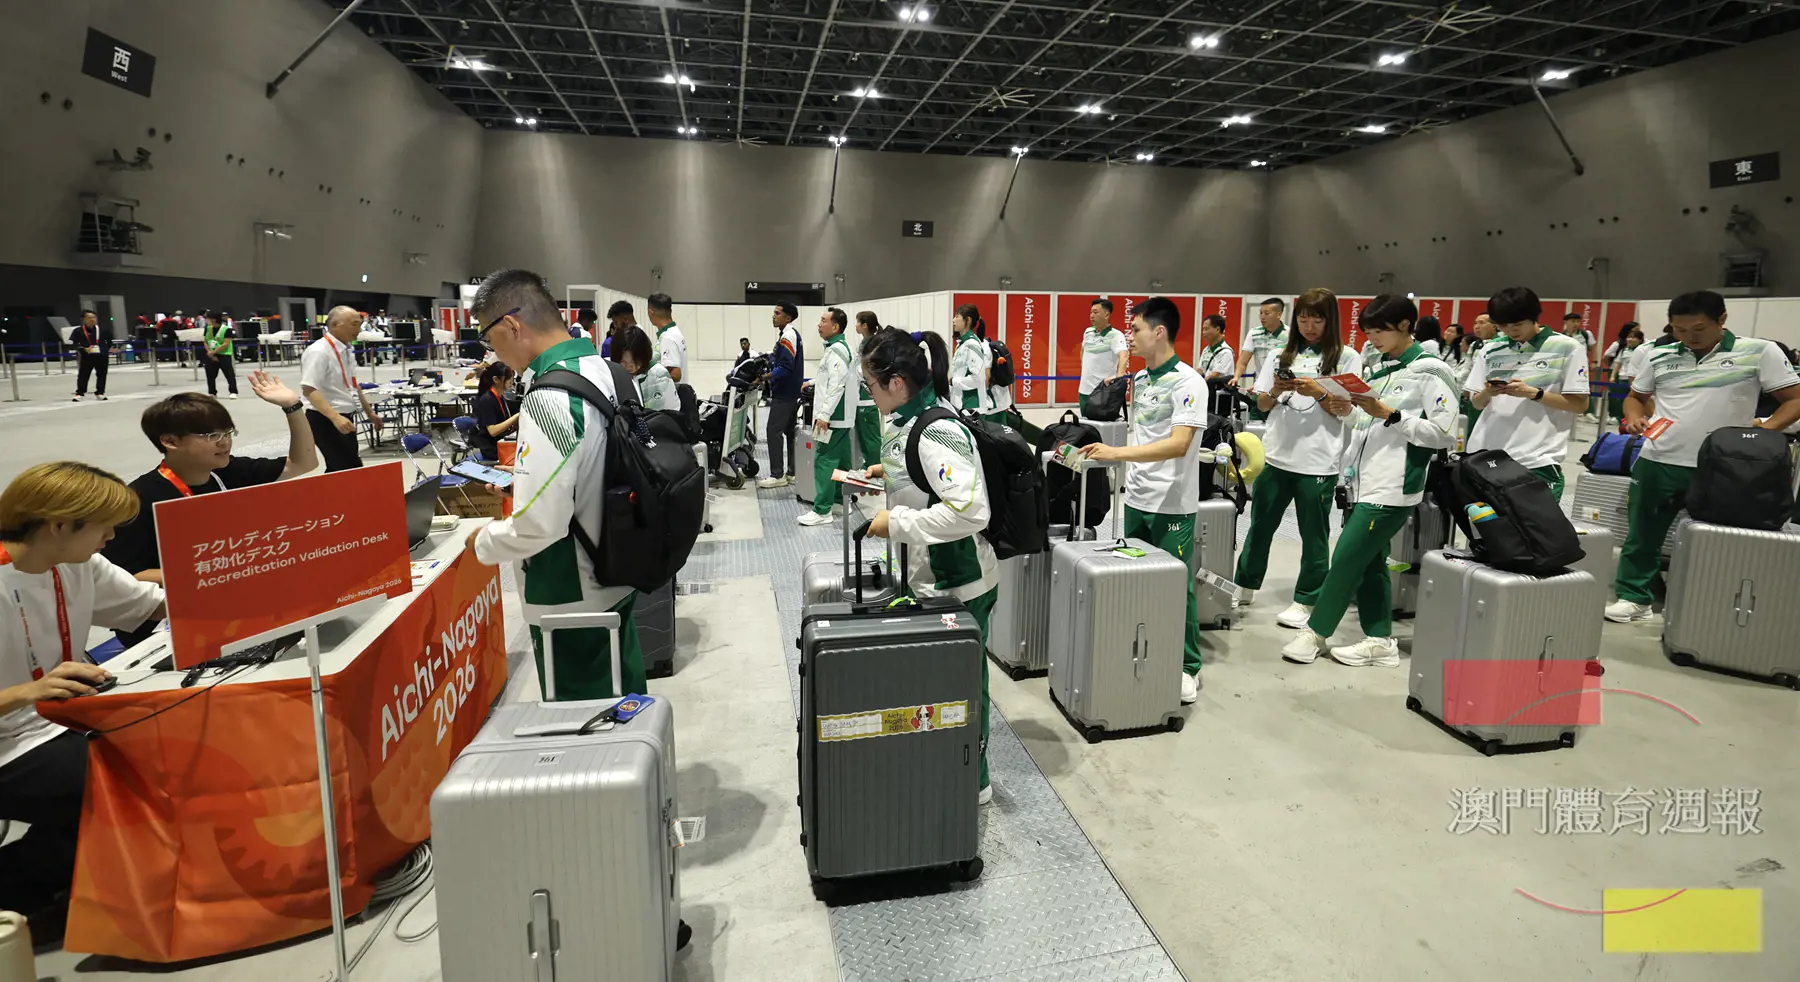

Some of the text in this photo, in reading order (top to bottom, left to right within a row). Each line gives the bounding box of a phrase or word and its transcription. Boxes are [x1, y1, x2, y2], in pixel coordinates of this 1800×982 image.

[111, 70, 127, 82] West
[113, 46, 131, 72] 西
[1735, 160, 1753, 175] 東
[1022, 297, 1034, 398] Aichi-Nagoya 2026
[192, 513, 345, 558] アクレディテーション
[194, 541, 291, 575] 有効化デスク
[197, 531, 389, 590] Accreditation Validation Desk
[336, 578, 402, 603] Aichi-Nagoya 2026
[382, 575, 499, 762] Aichi-Nagoya
[433, 653, 476, 746] 2026
